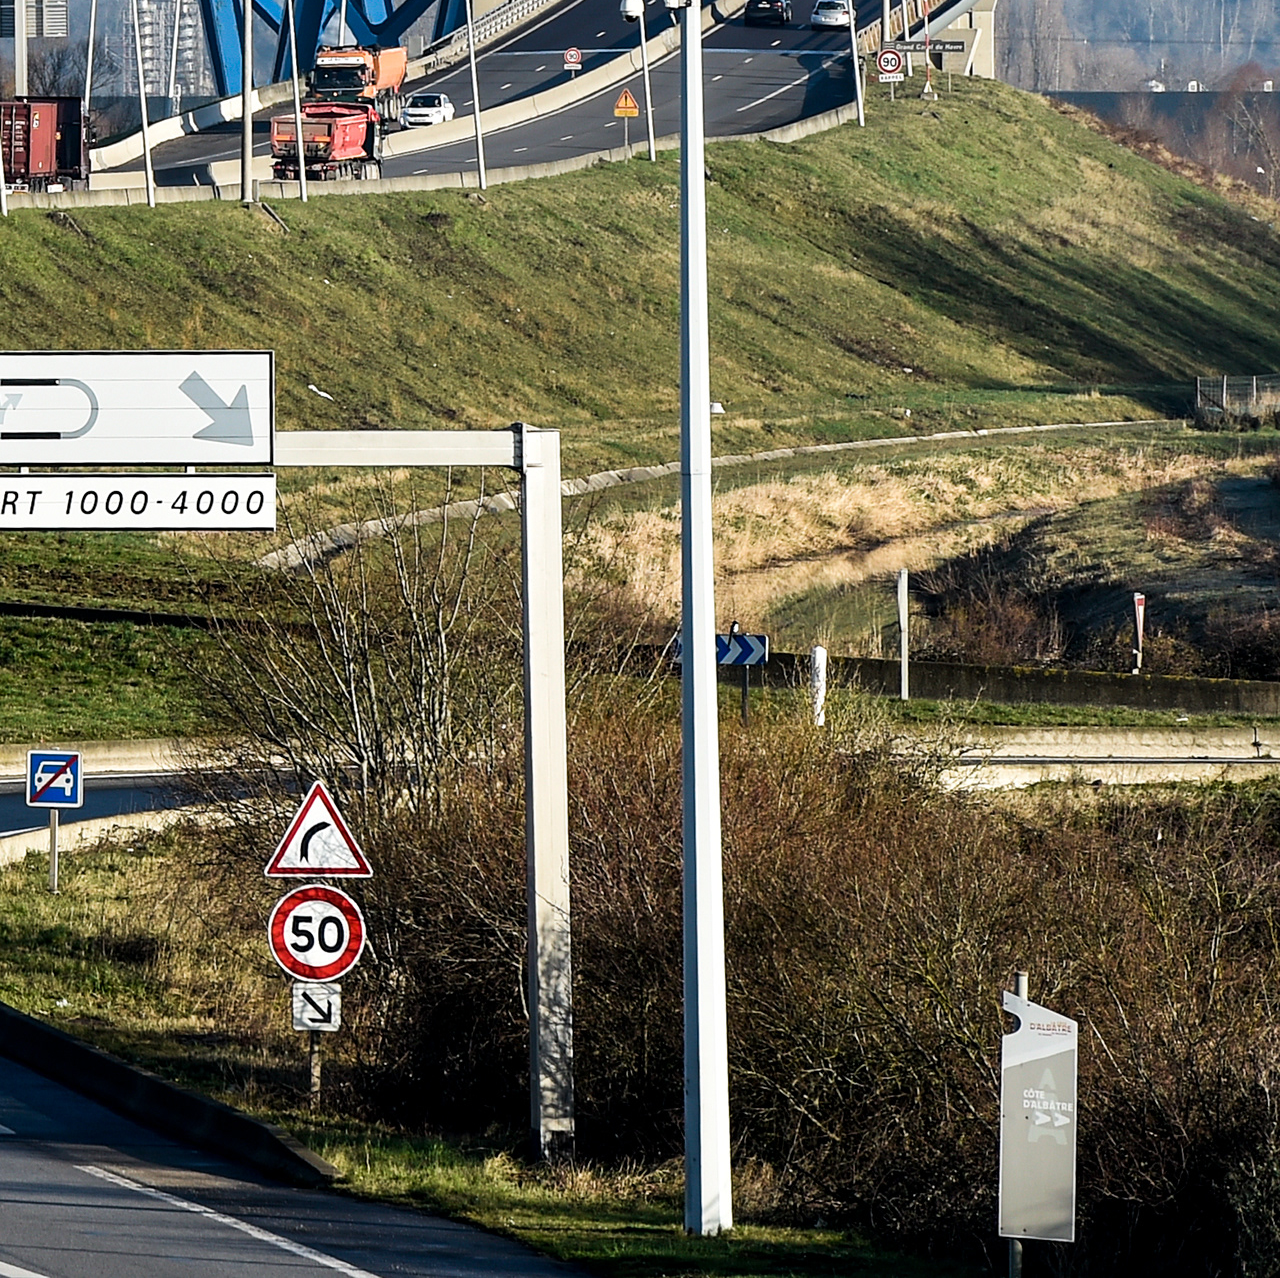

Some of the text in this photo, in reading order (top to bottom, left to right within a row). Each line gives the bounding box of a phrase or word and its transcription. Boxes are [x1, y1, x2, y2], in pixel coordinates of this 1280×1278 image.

[883, 57, 897, 67] 90
[65, 491, 264, 514] 1000-4000
[290, 915, 344, 954] 50
[1023, 1087, 1045, 1099] CÔTE
